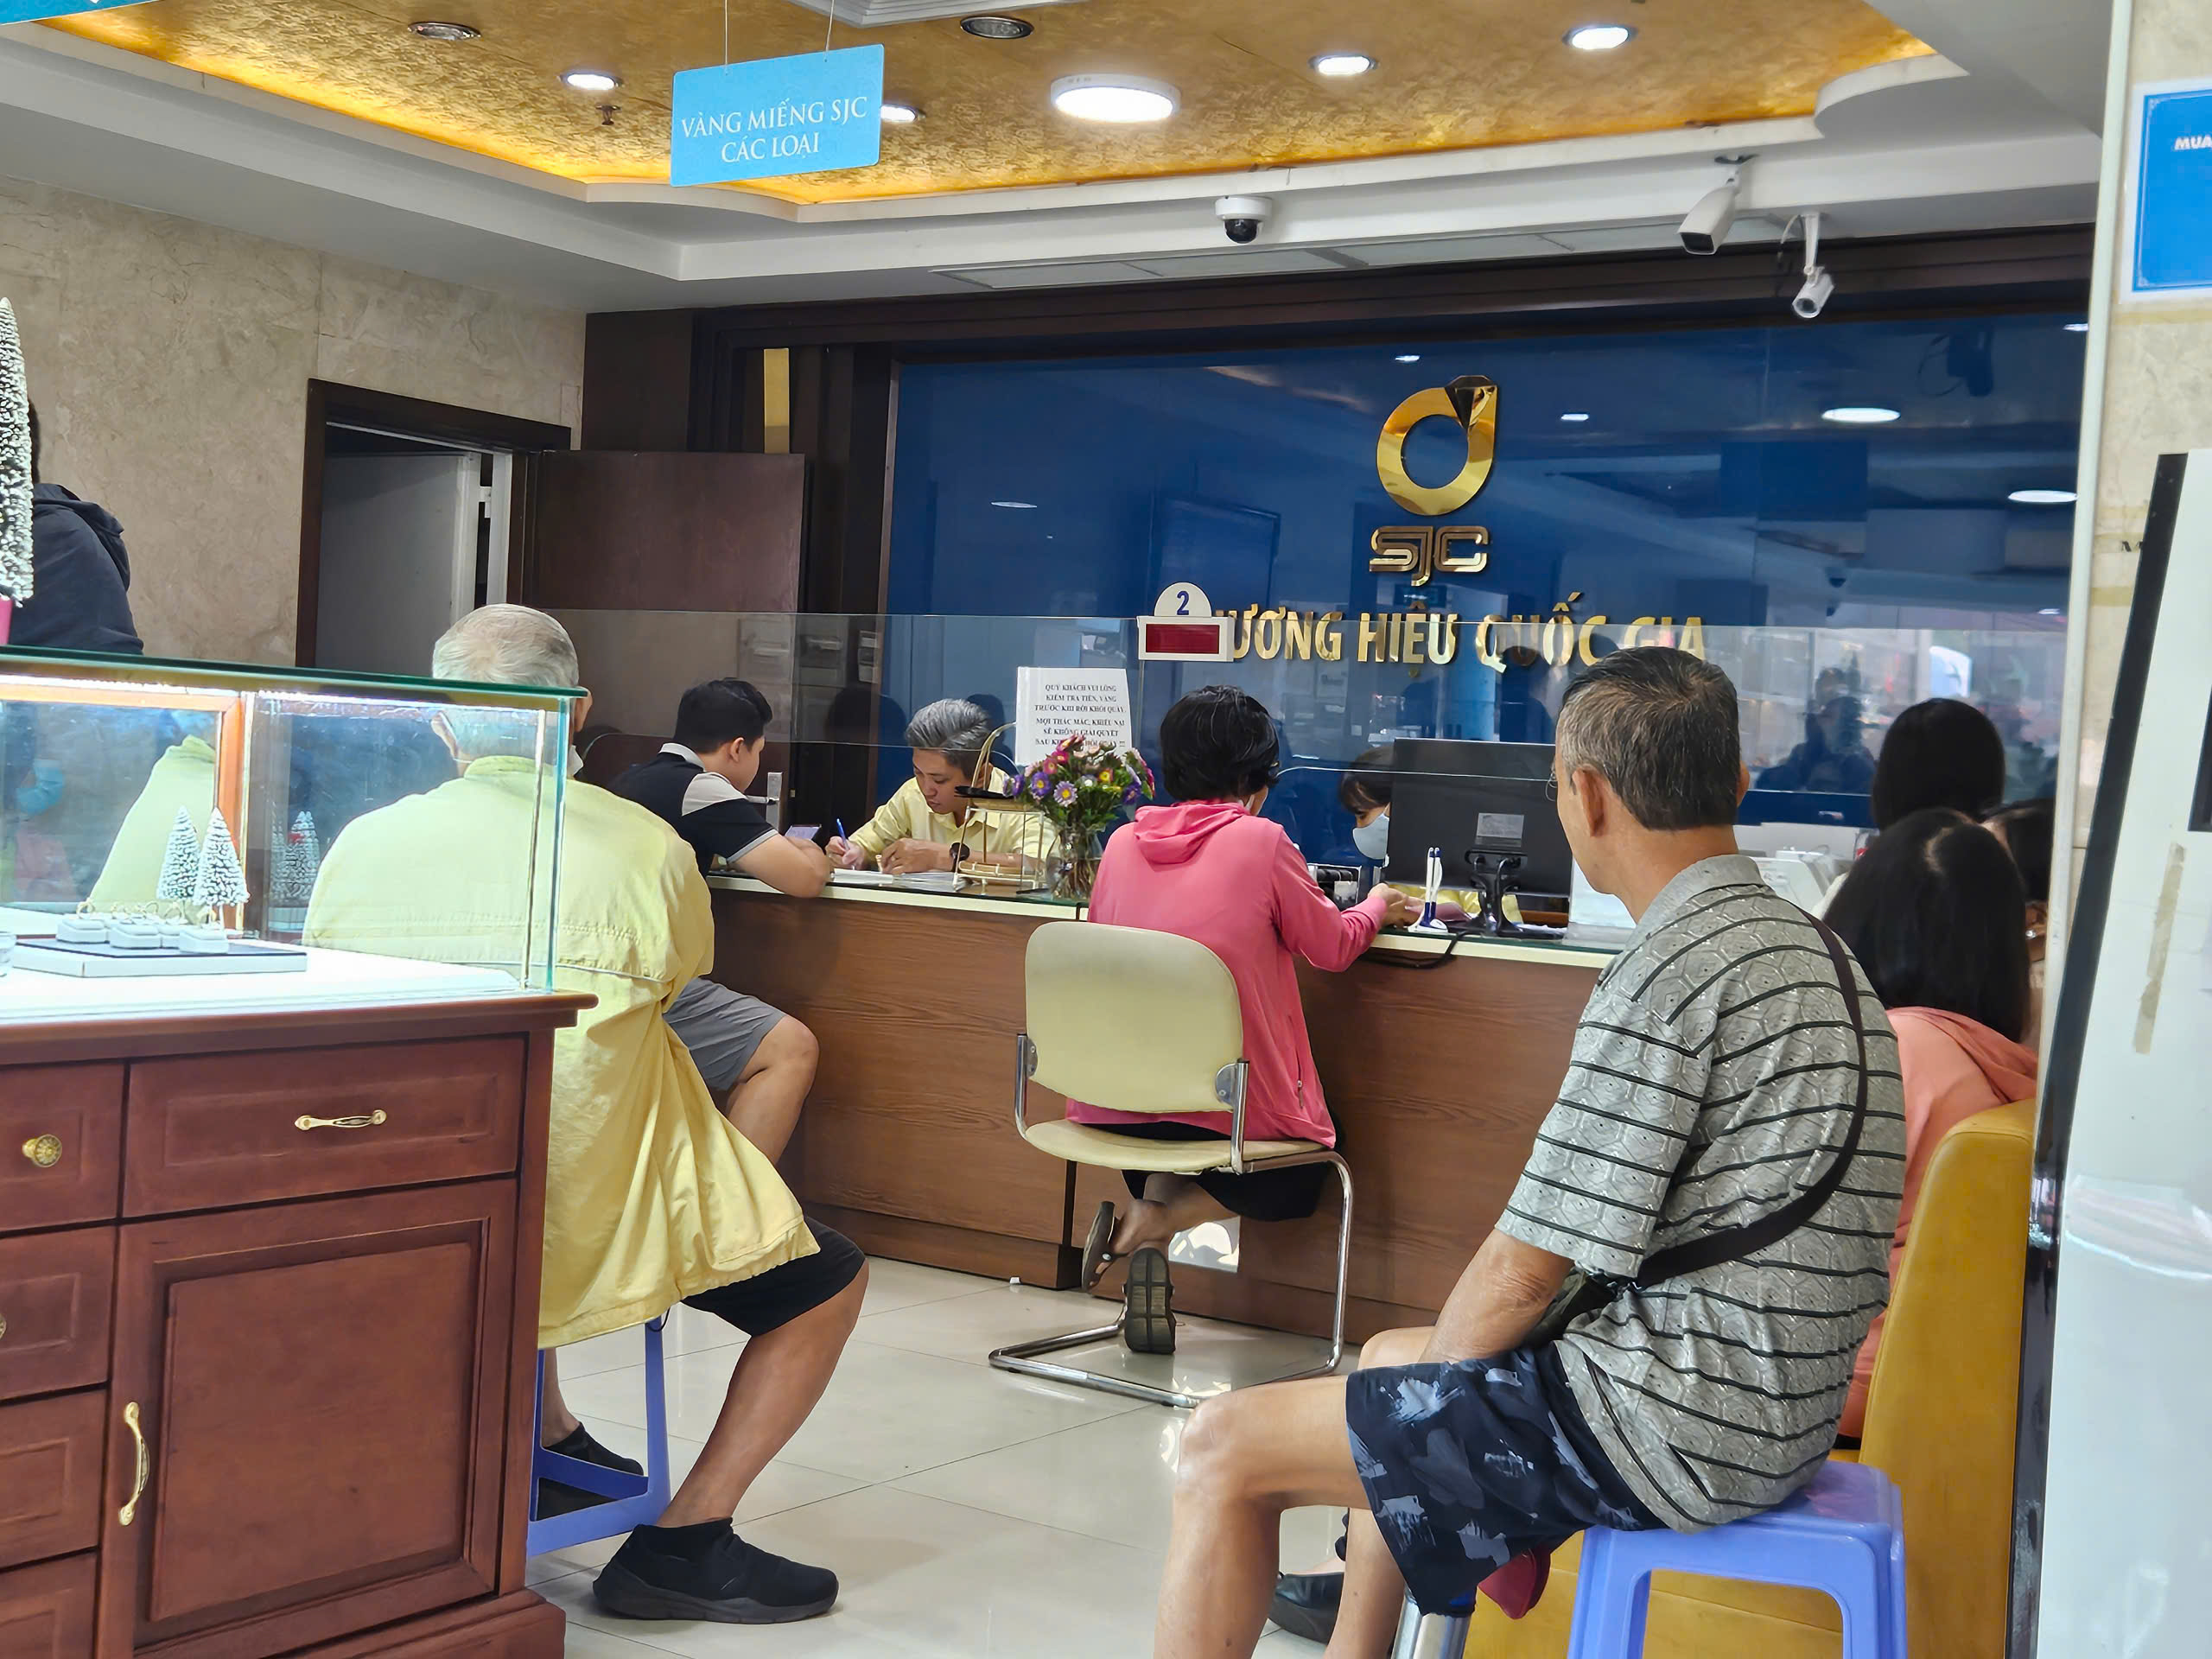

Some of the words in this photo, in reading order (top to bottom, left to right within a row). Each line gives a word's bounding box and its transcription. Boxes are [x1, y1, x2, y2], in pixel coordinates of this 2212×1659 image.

[682, 111, 741, 138] VÀNG
[747, 97, 823, 130] MIẾNG
[830, 97, 868, 125] SJC
[721, 135, 766, 163] CÁC
[772, 131, 820, 159] LOẠI
[1369, 525, 1489, 587] SJC
[1176, 590, 1190, 615] 2
[1475, 591, 1607, 673] QUỐC
